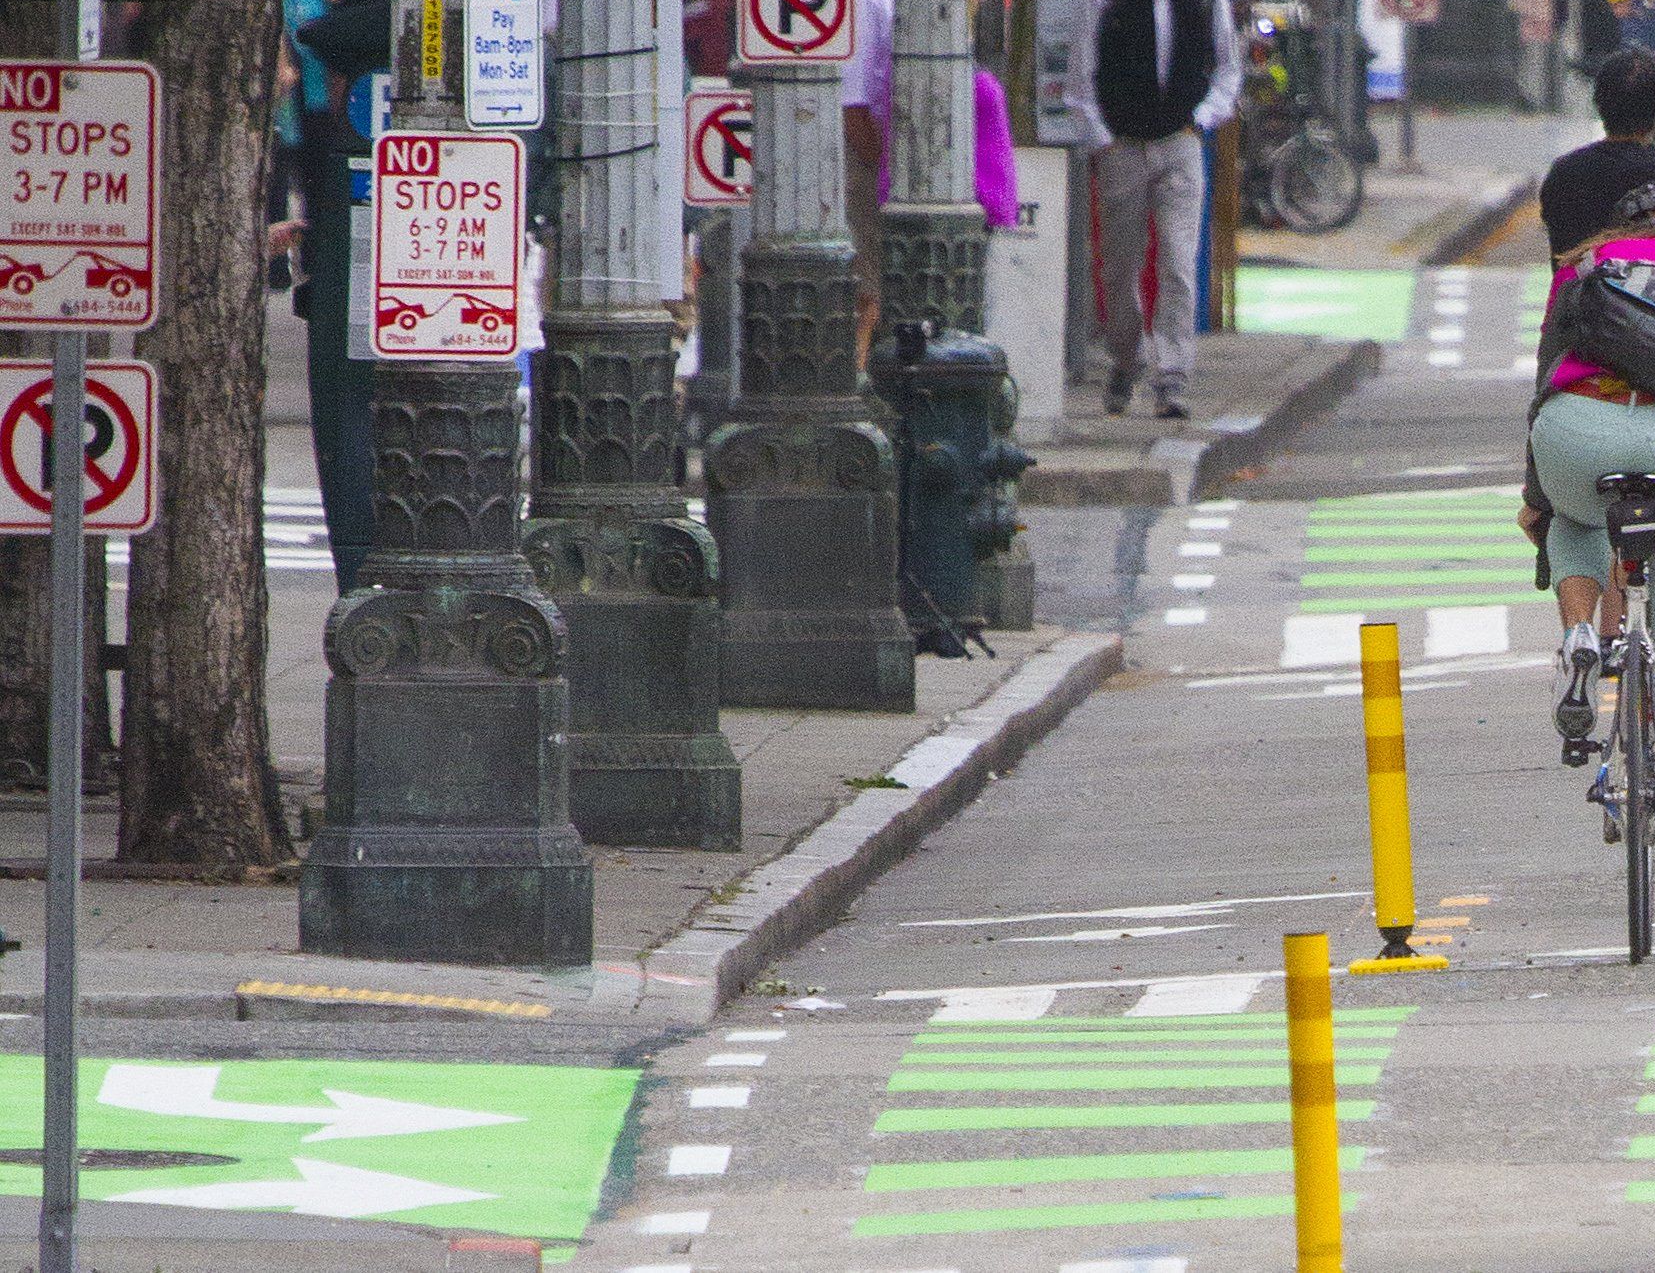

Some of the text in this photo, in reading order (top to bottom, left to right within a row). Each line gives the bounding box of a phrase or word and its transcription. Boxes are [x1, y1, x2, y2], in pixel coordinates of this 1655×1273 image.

[492, 11, 515, 32] Pay
[0, 70, 51, 107] NO
[10, 120, 132, 157] STOPS
[385, 140, 434, 173] NO
[13, 170, 129, 206] 3-7 PM
[395, 180, 503, 212] STOPS
[10, 222, 51, 237] EXCEPT
[408, 217, 487, 238] 6-9 AM
[408, 240, 486, 262] 3-7 PM
